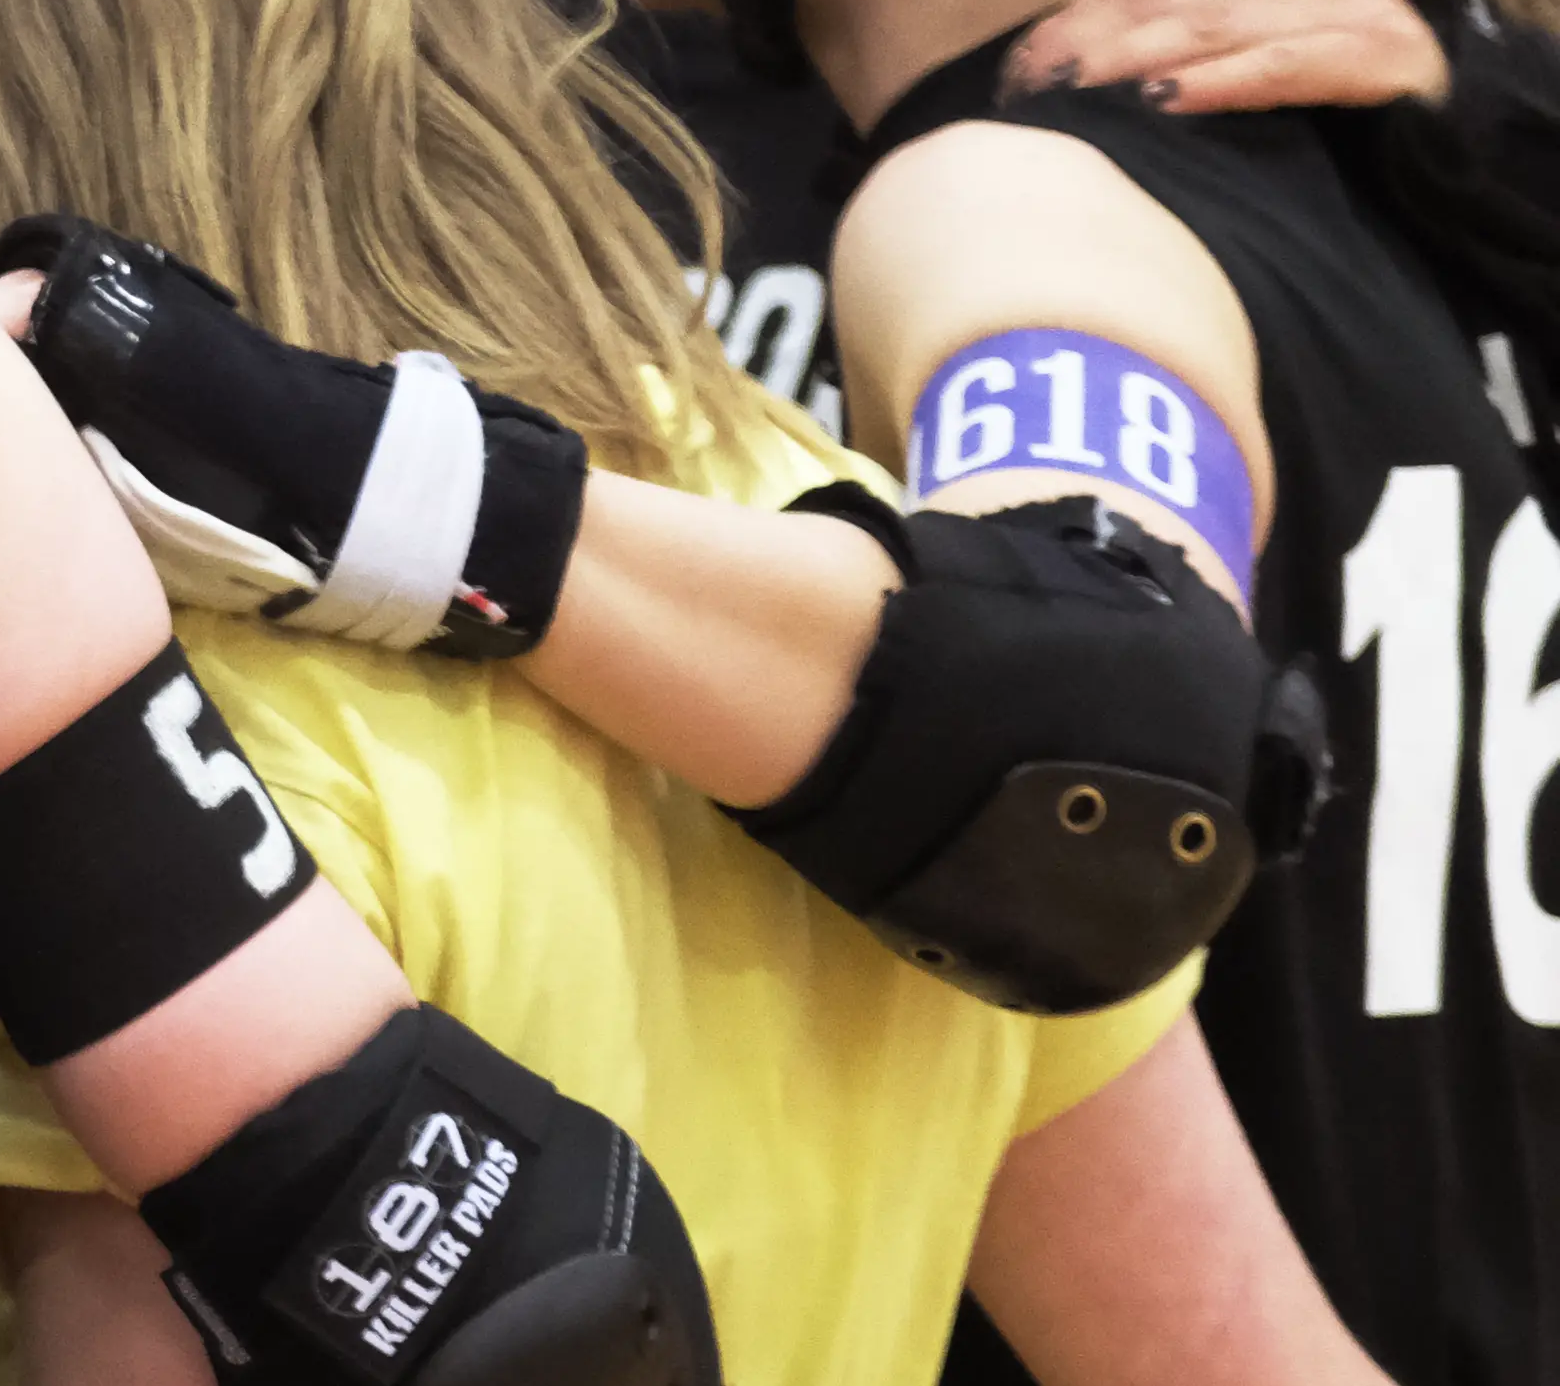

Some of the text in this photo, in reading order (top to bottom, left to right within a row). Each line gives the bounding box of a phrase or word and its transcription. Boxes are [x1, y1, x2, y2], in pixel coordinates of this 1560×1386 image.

[140, 671, 297, 901] 5
[322, 1111, 470, 1313] 187
[361, 1138, 519, 1358] KILLER PADS
